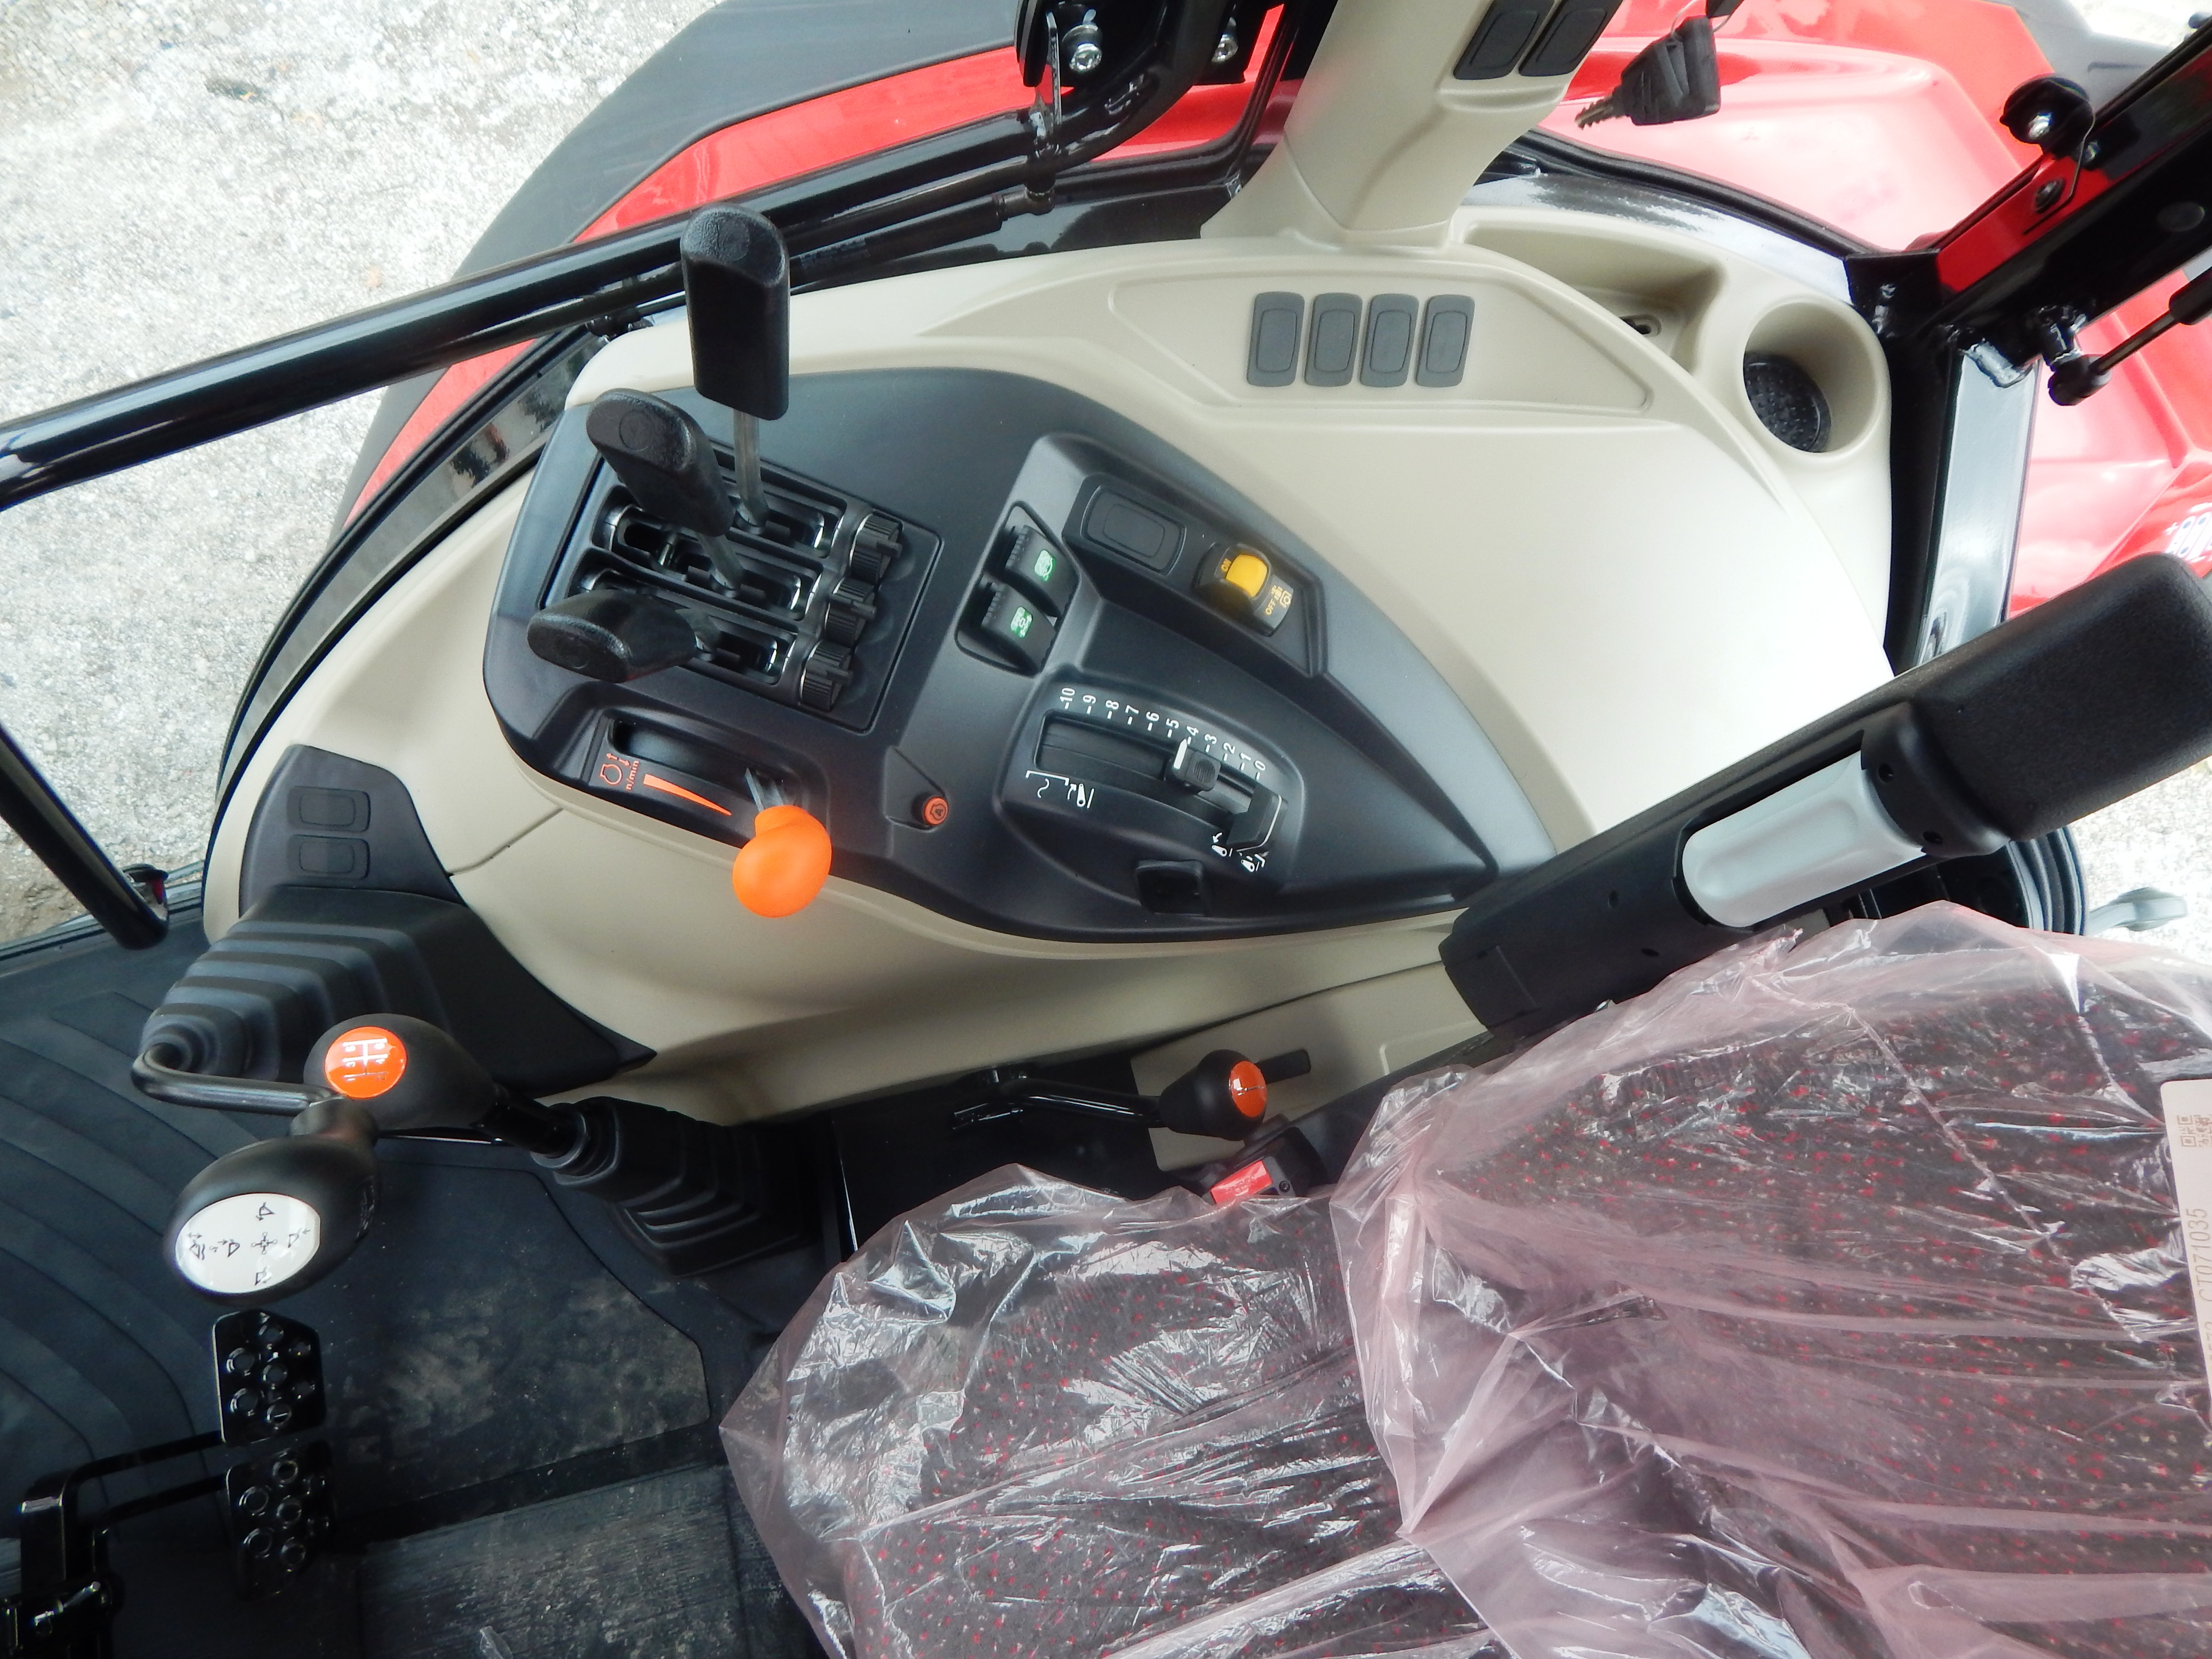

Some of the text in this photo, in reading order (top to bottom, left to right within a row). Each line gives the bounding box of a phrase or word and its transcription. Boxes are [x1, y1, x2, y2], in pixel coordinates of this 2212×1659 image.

[1221, 558, 1232, 572] ON
[1265, 599, 1275, 614] OFF
[625, 760, 639, 790] n/min
